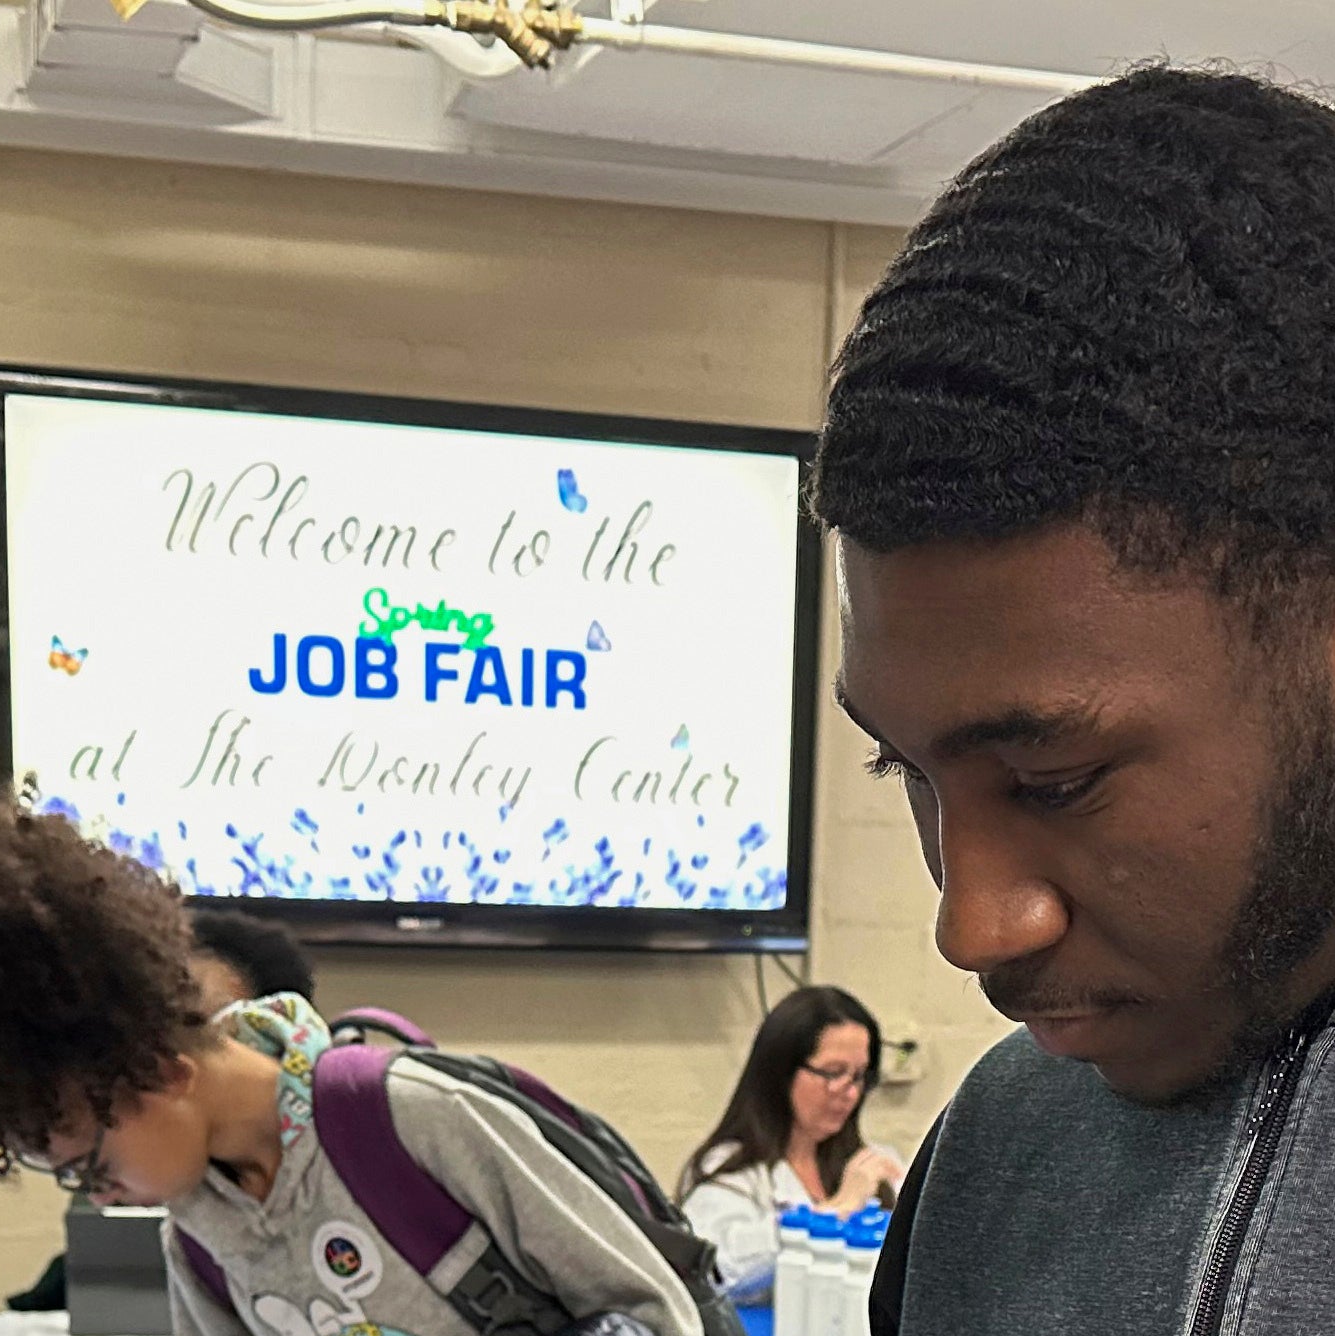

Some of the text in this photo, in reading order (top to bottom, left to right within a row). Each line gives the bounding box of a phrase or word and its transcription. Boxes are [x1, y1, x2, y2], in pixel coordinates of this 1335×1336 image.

[162, 461, 678, 586] Welcome to the
[359, 587, 494, 651] Spring
[248, 633, 588, 711] JOB FAIR
[69, 729, 137, 781] at
[179, 708, 274, 789] The
[574, 735, 741, 807] Center
